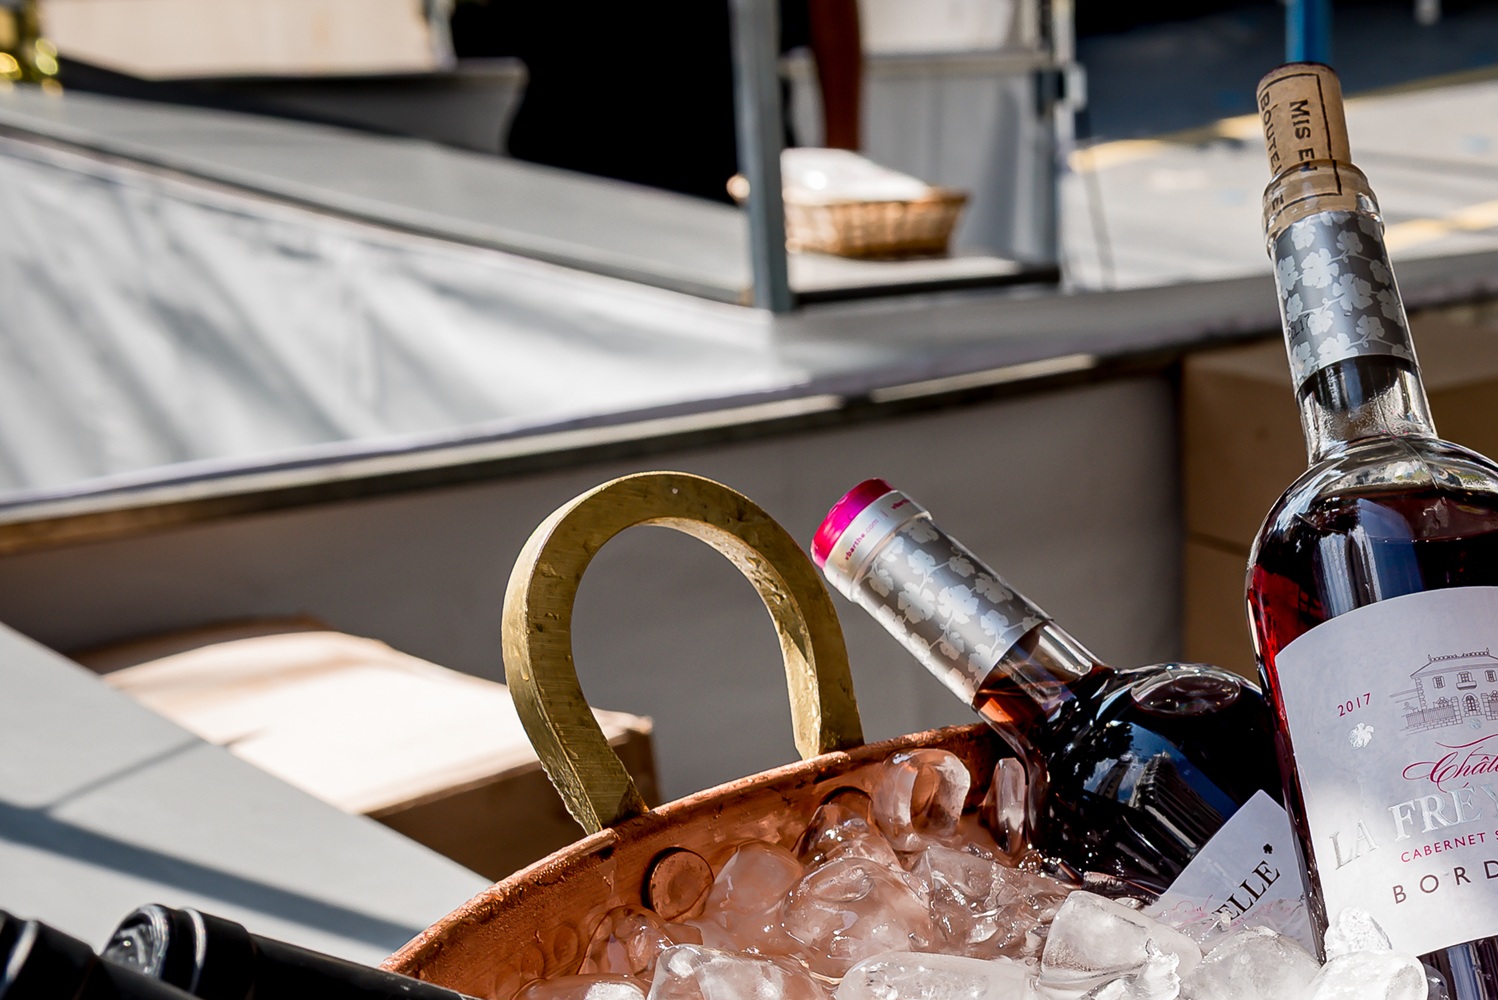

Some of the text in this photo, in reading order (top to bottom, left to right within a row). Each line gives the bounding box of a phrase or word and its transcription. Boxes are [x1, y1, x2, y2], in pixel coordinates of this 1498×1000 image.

[1289, 99, 1312, 140] MIS
[1337, 693, 1371, 717] 2017
[1329, 818, 1379, 870] LA
[1400, 832, 1486, 863] CABERNET
